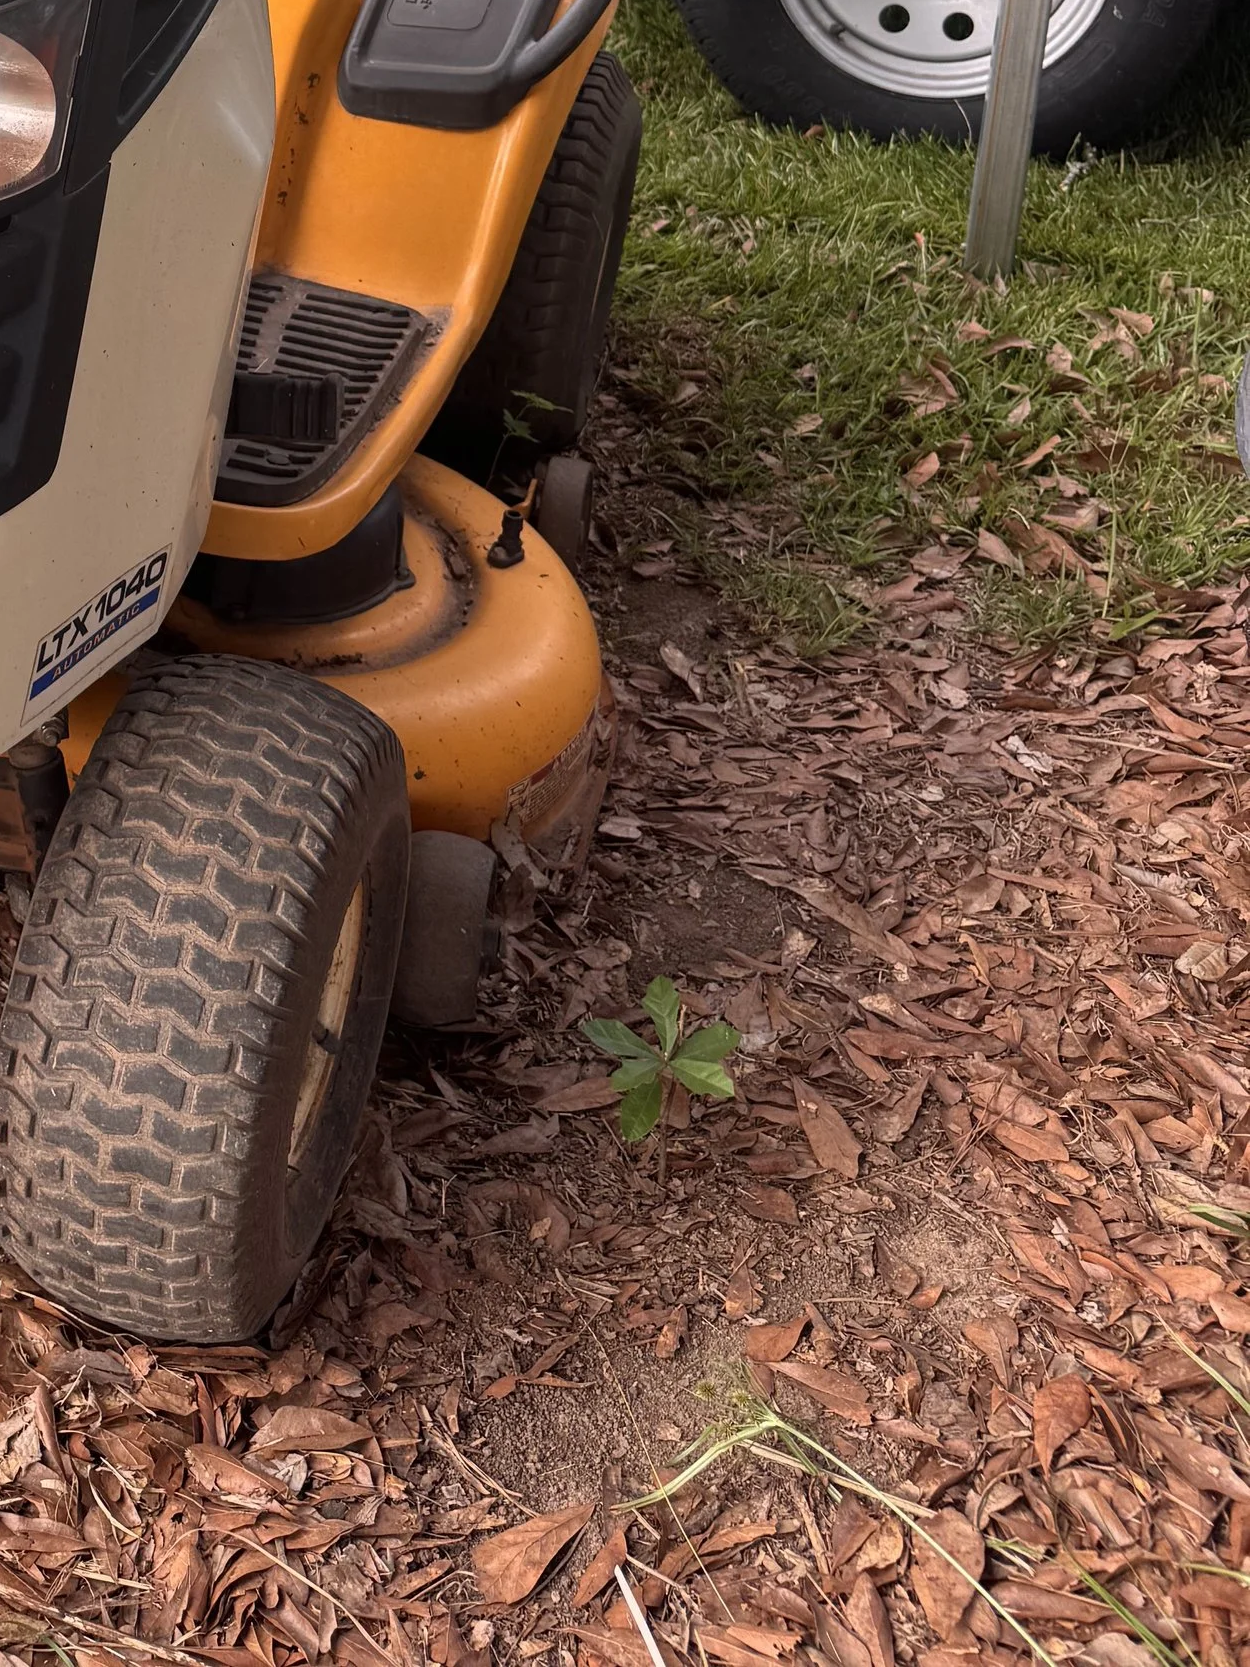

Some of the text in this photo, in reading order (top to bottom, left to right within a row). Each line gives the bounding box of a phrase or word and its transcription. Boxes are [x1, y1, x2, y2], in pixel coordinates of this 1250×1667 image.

[36, 552, 167, 673] LTX 1040
[52, 602, 141, 679] AUTOMATIC
